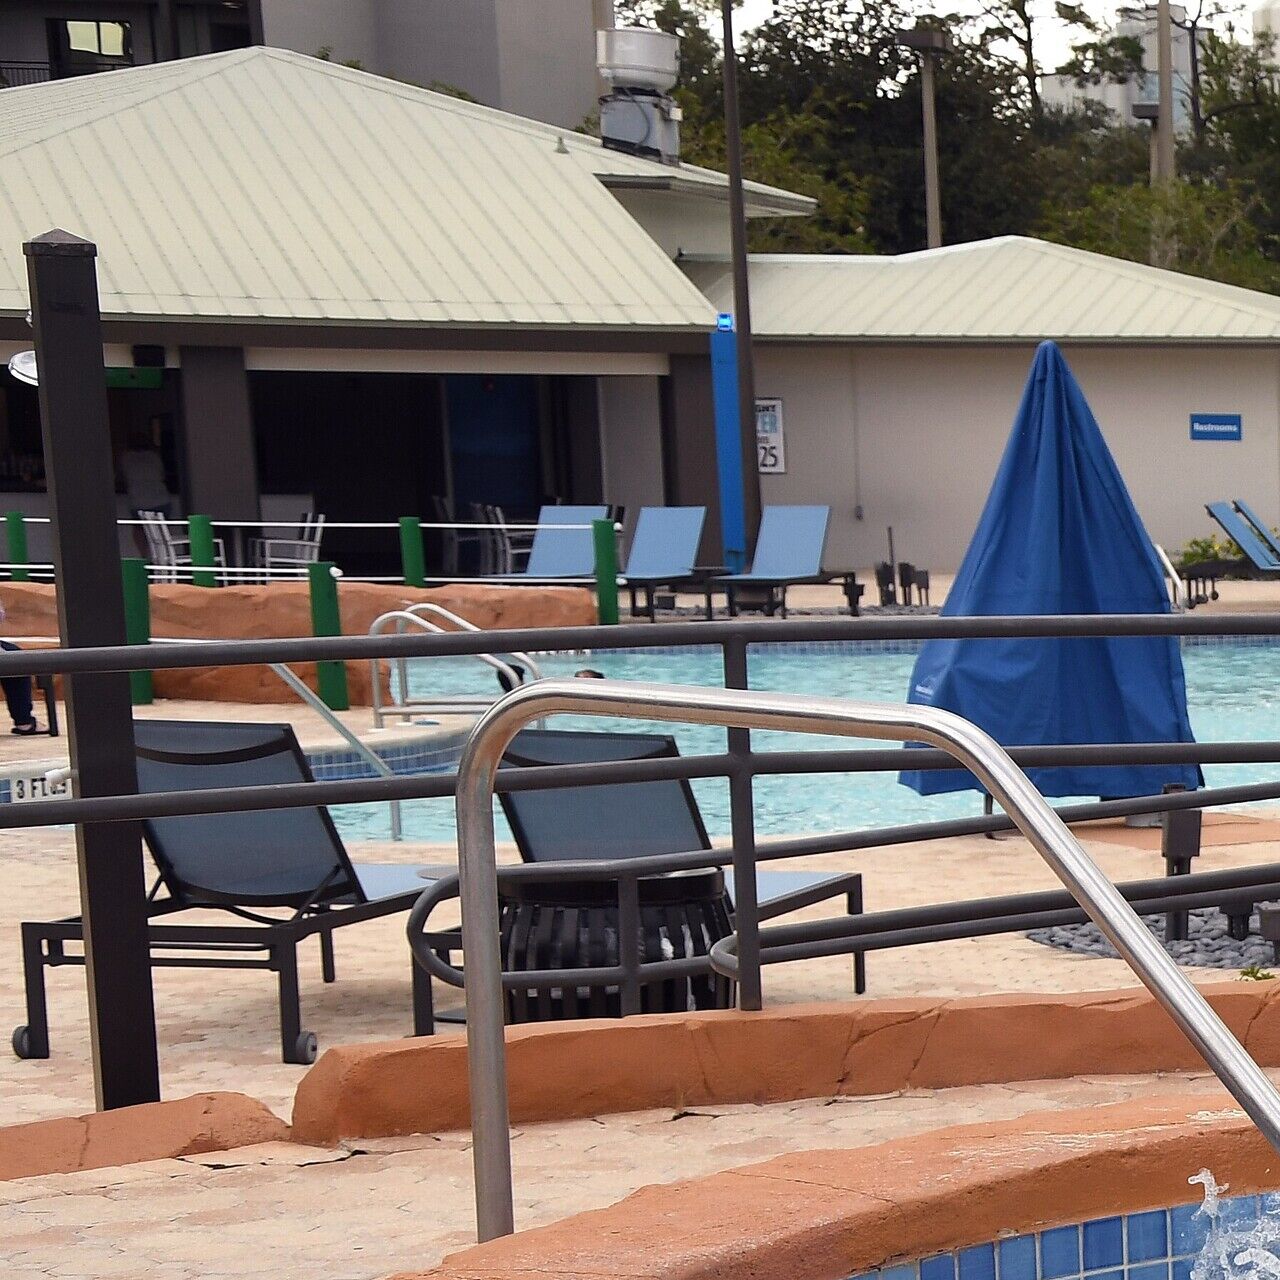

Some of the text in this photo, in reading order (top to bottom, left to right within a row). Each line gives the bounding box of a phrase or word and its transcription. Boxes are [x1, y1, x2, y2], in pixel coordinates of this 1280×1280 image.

[1193, 422, 1238, 432] Restrooms
[760, 446, 777, 467] 25
[16, 779, 25, 799] 3
